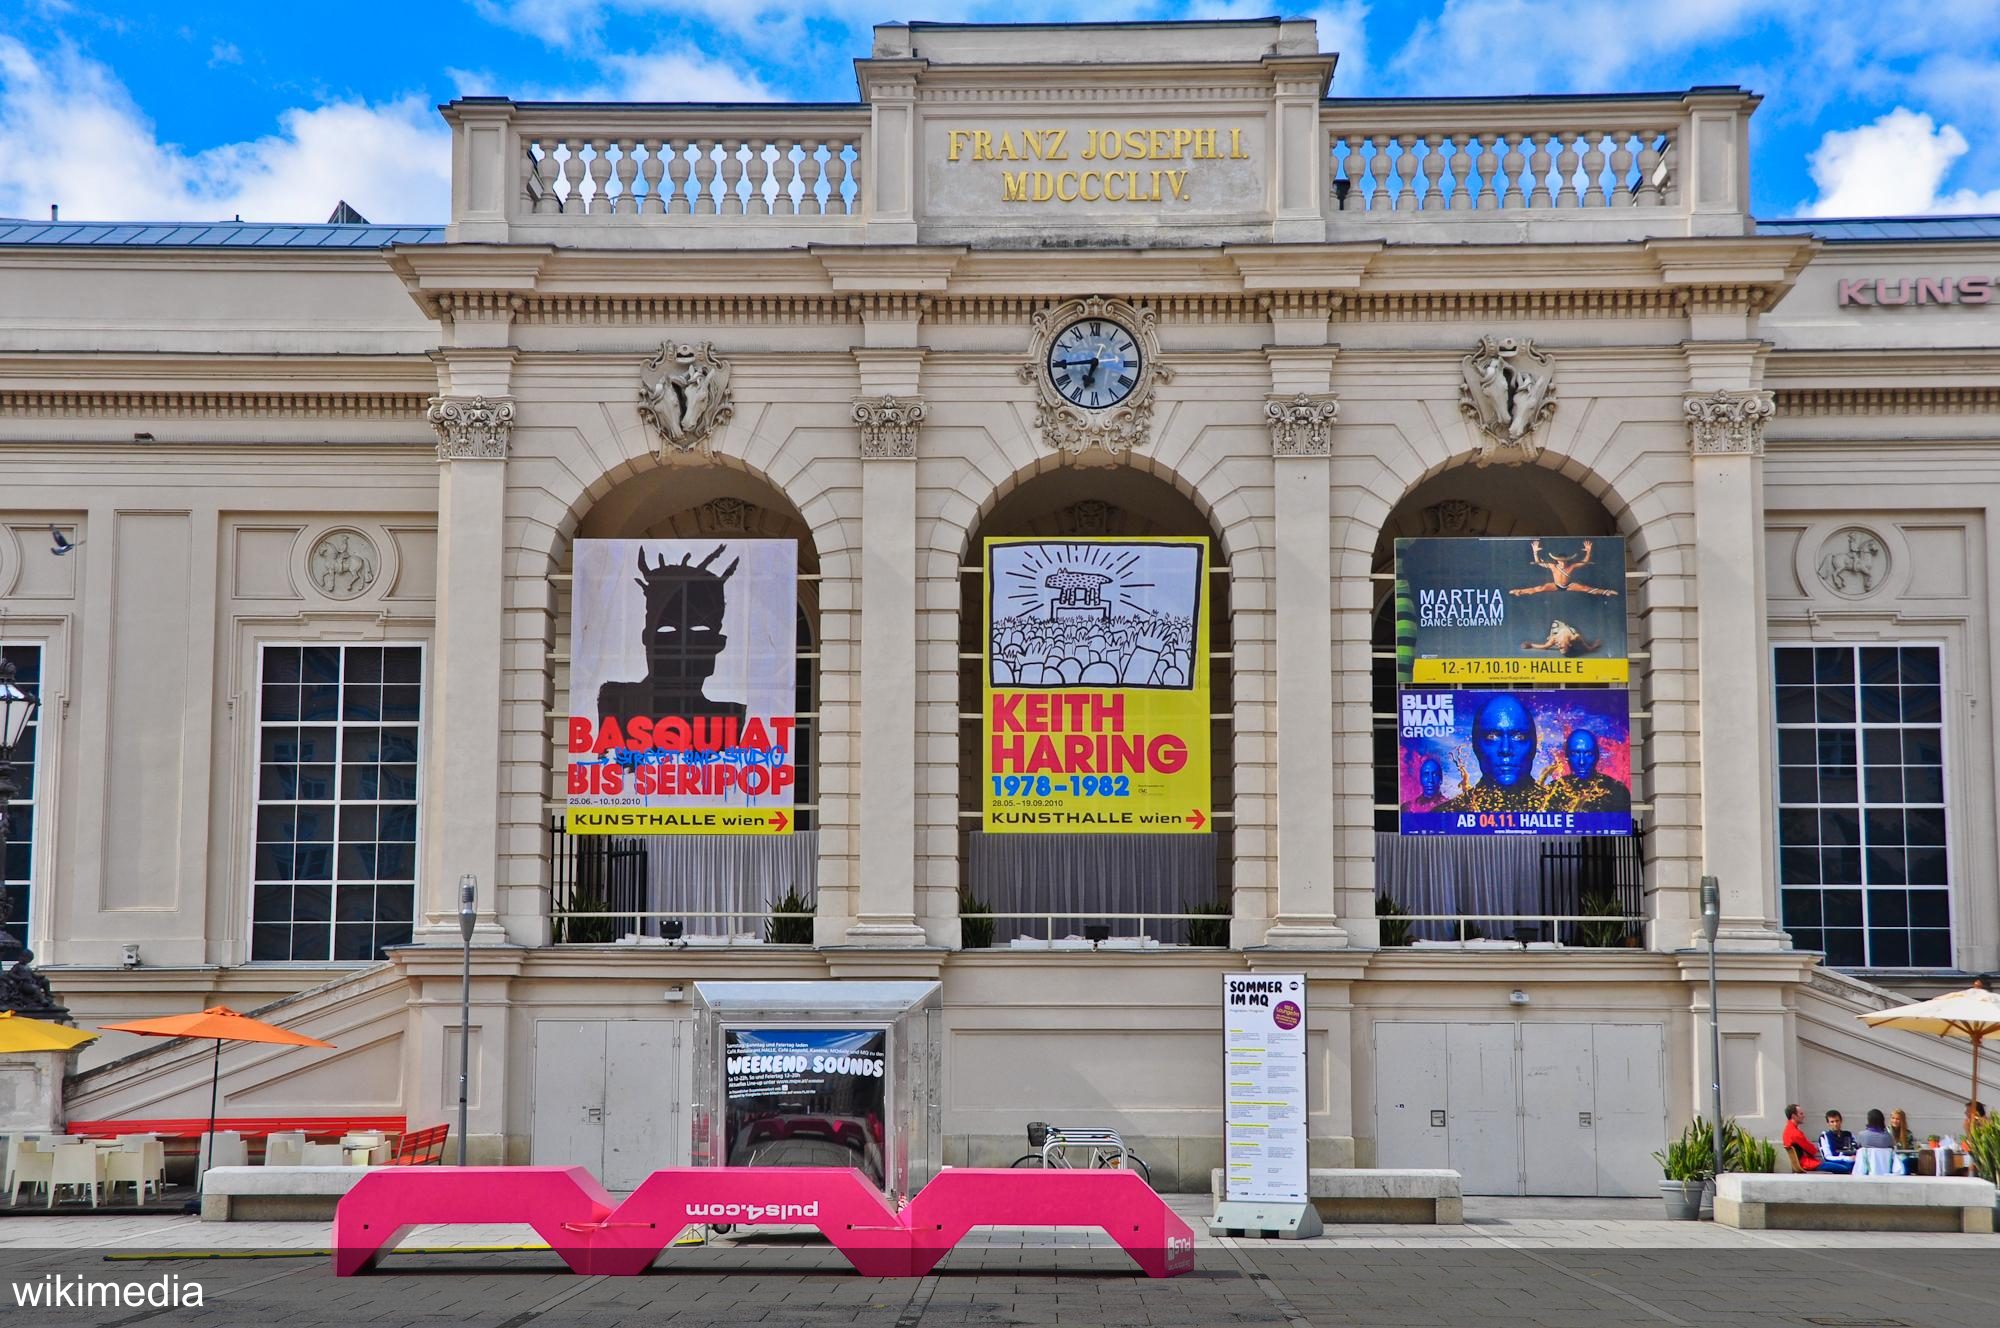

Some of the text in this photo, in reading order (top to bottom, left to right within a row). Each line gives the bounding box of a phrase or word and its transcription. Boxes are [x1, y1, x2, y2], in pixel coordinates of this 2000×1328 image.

[947, 128, 1069, 161] FRANZ
[1002, 169, 1191, 202] MDCCCLIV.
[1838, 275, 2000, 306] KUNS
[1420, 588, 1504, 605] MARTHA
[1420, 603, 1504, 619] GRAHAM
[1420, 617, 1504, 627] DANCE COMPANY
[1530, 660, 1572, 674] HALLE
[1576, 660, 1584, 674] E
[1402, 694, 1453, 709] BLUE
[992, 693, 1124, 732] KEITH
[1402, 709, 1454, 726] MAN
[568, 715, 795, 754] BASQUIAT
[1402, 726, 1455, 738] GROUP
[991, 733, 1188, 774] HARING
[567, 763, 795, 796] BIS SERIPOP
[574, 813, 765, 826] KUNSTHALLE wien
[991, 812, 1182, 824] KUNSTHALLE wien
[1456, 813, 1574, 828] AB 04.11. HALLE E
[1229, 980, 1283, 994] SOMMER
[1230, 993, 1269, 1007] IM MQ
[727, 1055, 884, 1077] WEEKEND SOUNDS
[686, 1200, 819, 1220] puls4.com
